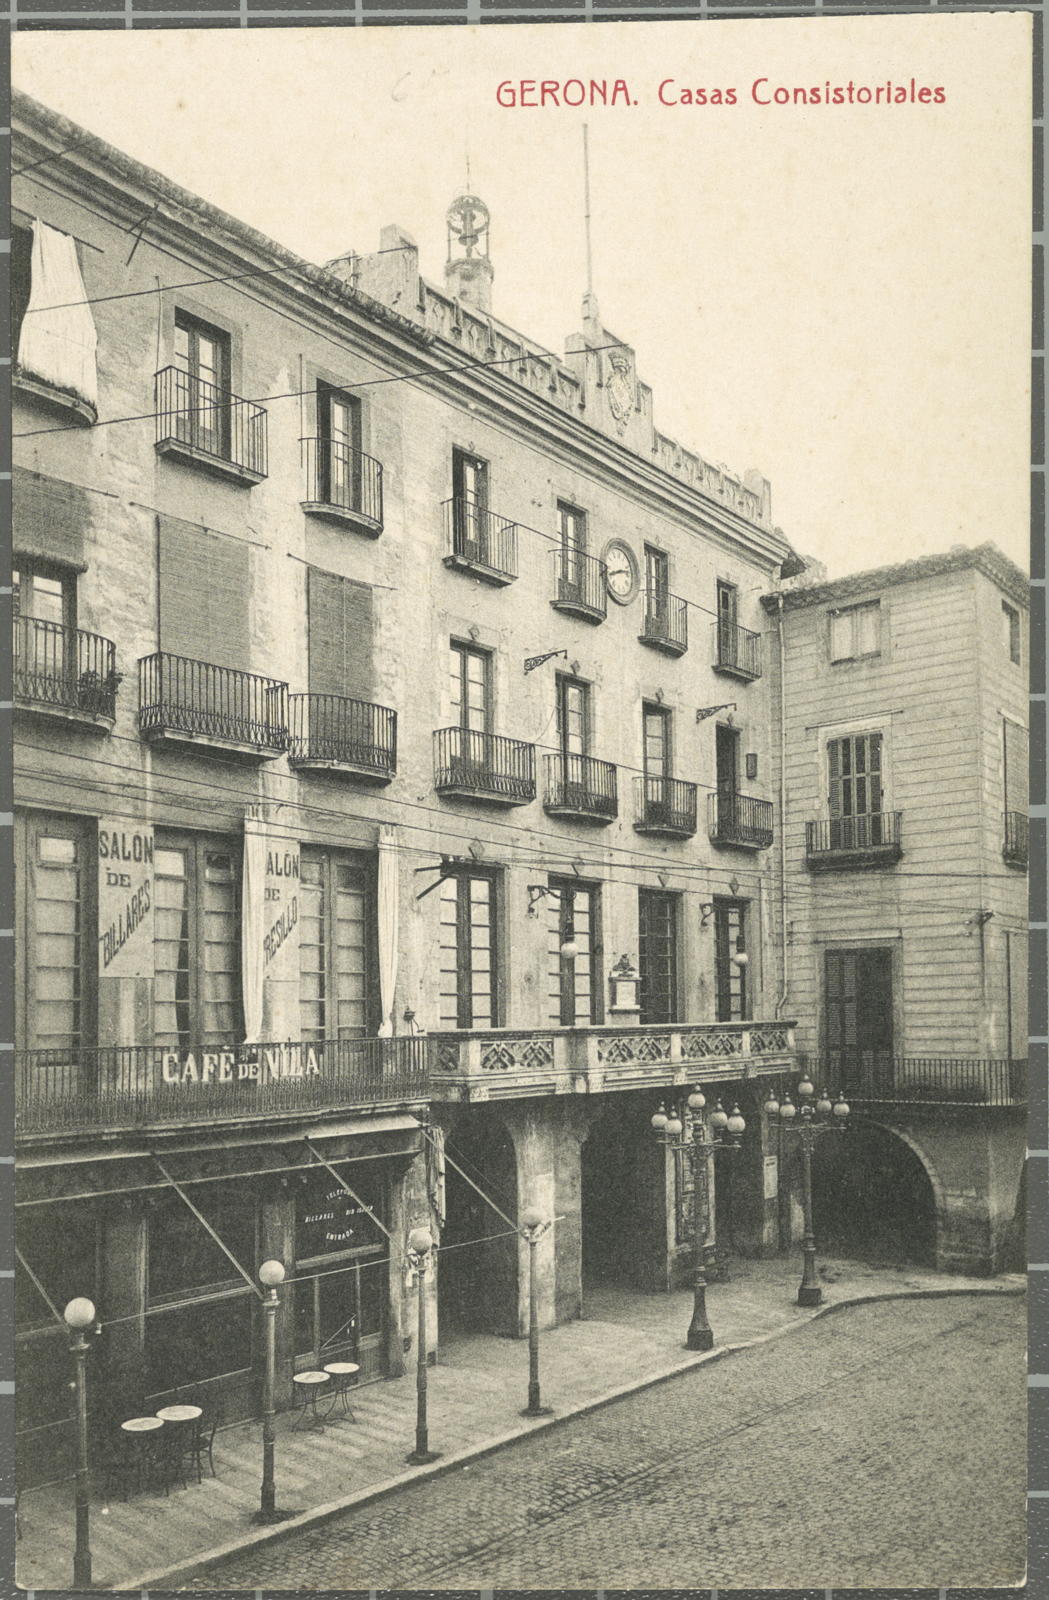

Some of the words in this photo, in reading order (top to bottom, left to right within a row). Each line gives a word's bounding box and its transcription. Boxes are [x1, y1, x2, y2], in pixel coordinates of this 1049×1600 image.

[106, 872, 131, 888] DE
[263, 887, 281, 901] DE
[100, 878, 151, 969] BILLARES
[263, 895, 298, 965] RESILLO
[237, 1062, 260, 1080] DE
[264, 1044, 321, 1080] VILA
[326, 1228, 354, 1240] ENTRADA
